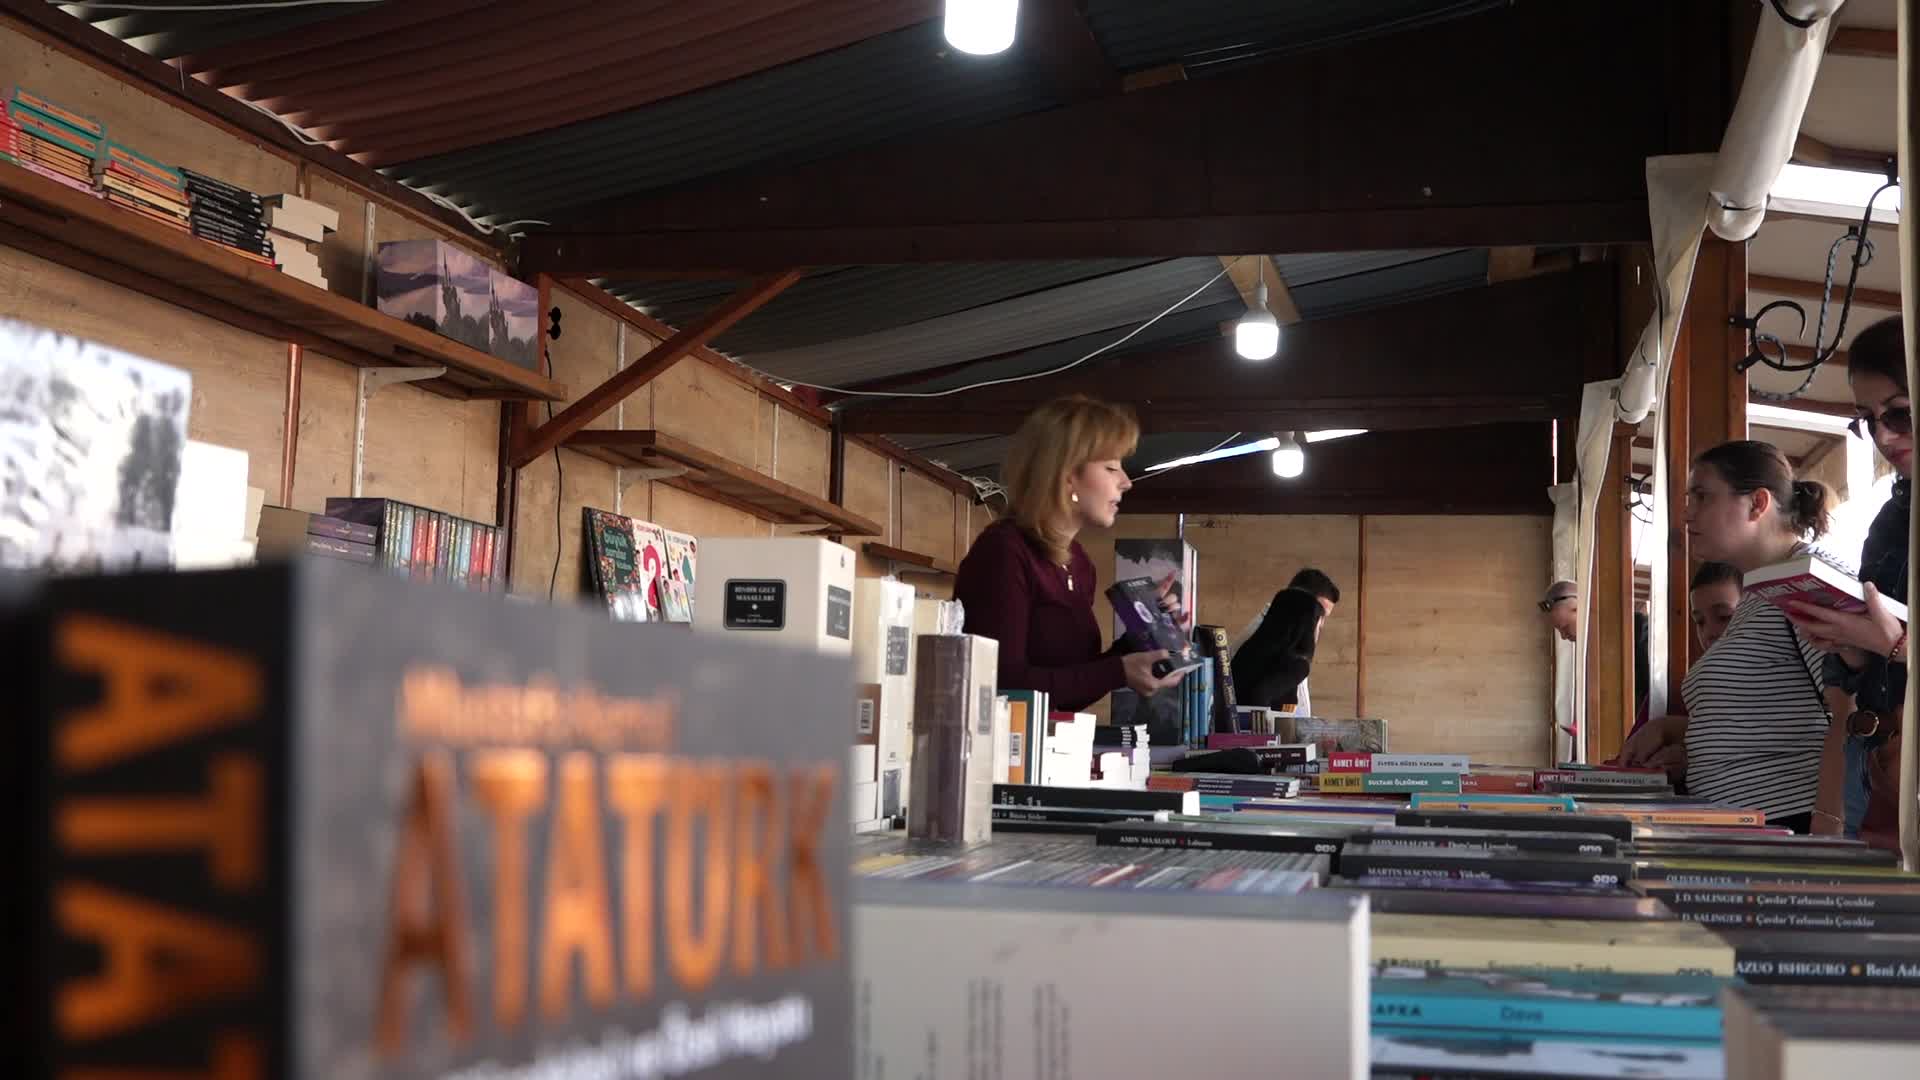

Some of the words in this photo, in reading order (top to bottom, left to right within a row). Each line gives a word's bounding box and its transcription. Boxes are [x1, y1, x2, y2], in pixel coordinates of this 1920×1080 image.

[1333, 758, 1353, 768] AHMET
[1694, 893, 1744, 904] SALINGER
[1693, 913, 1743, 923] SALINGER
[1736, 960, 1774, 975] AZUO
[1777, 962, 1847, 976] ISHIGURO
[1866, 963, 1895, 977] Beni
[1375, 1003, 1423, 1017] AFKA
